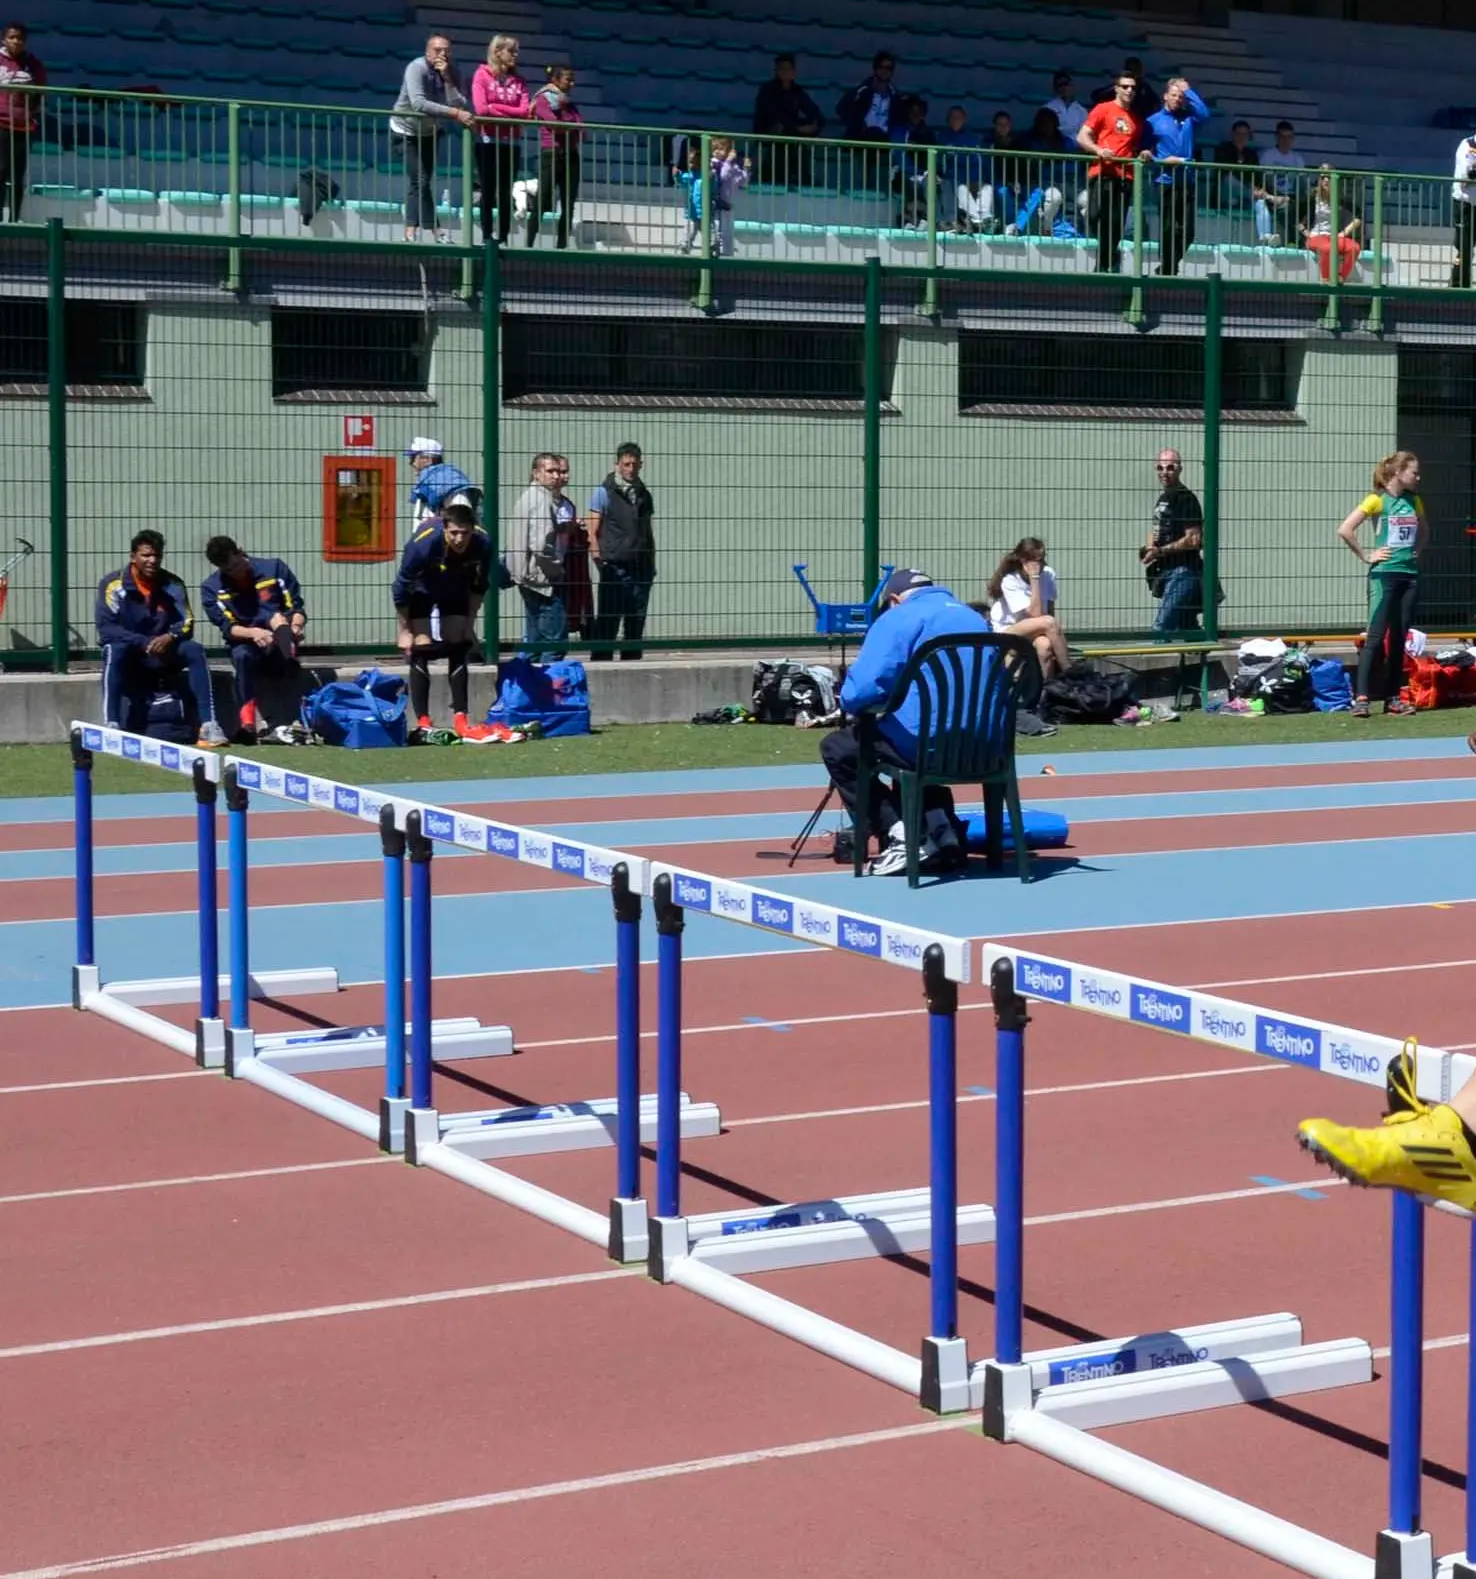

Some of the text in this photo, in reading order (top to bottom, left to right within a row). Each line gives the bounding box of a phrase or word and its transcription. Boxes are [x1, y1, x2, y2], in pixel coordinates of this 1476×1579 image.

[1023, 964, 1381, 1074] TRENTINO TRENTINO TRENTINO TRENTINO TRENTINO TRENTINO
